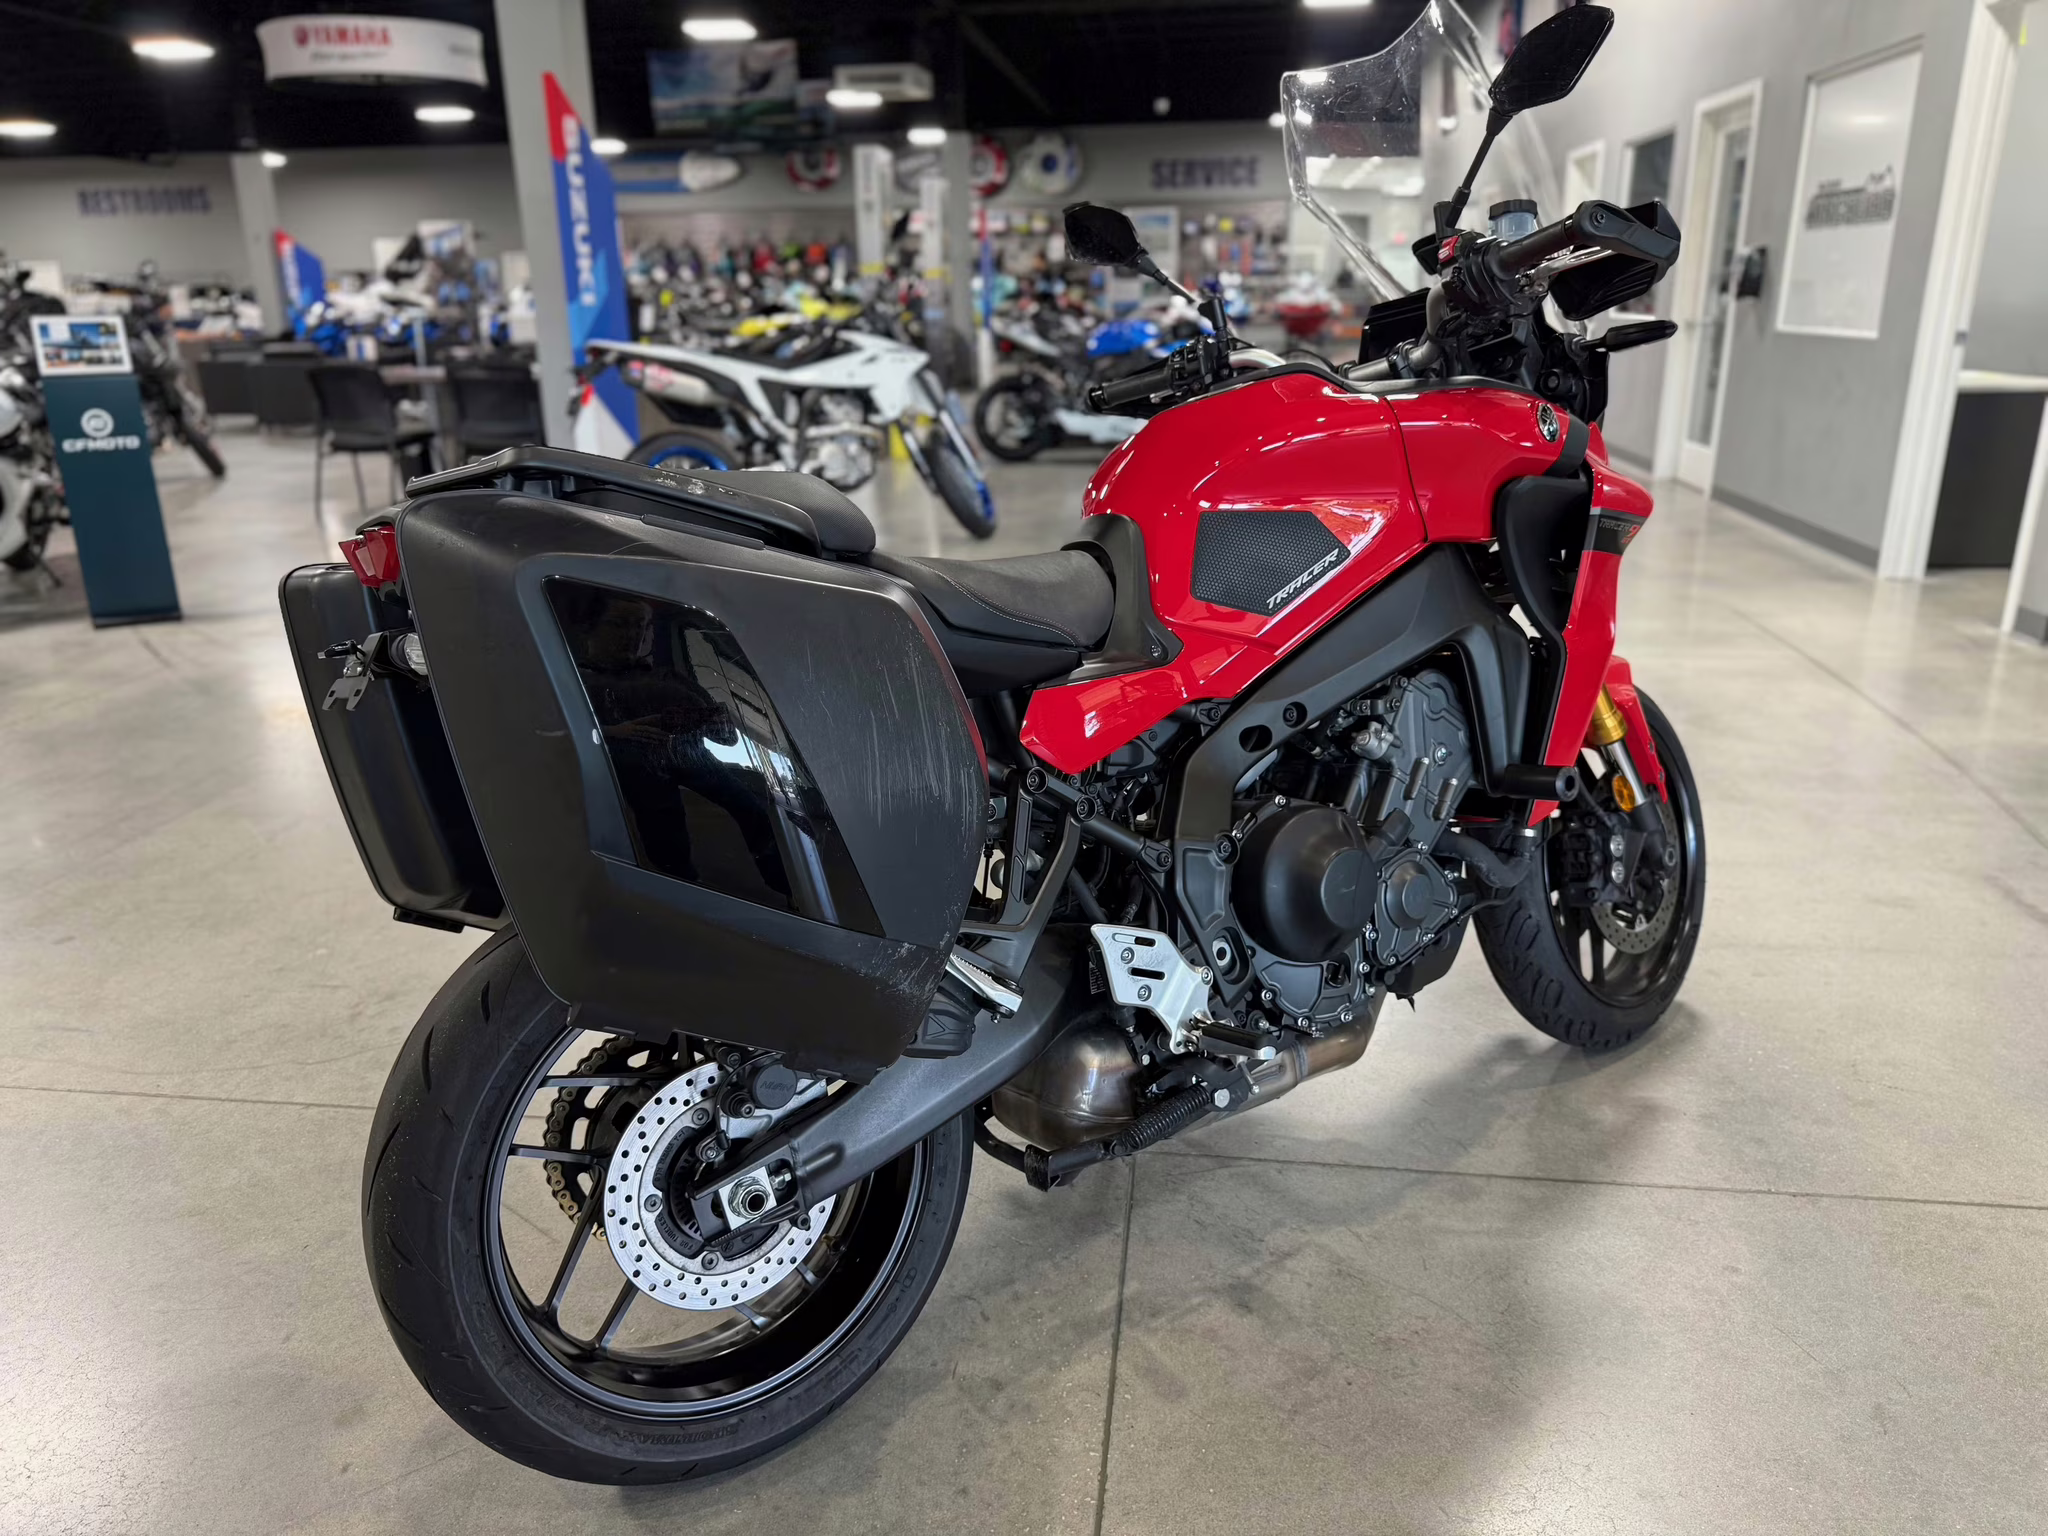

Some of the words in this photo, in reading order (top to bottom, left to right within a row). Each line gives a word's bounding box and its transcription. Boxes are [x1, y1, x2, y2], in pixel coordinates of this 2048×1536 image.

[313, 26, 392, 46] YAMAHA
[1152, 156, 1258, 188] SERVICE
[562, 113, 597, 306] SUZUKI
[62, 435, 141, 453] CFMOTO
[1599, 517, 1631, 531] TRACER
[1266, 548, 1339, 609] TRACER
